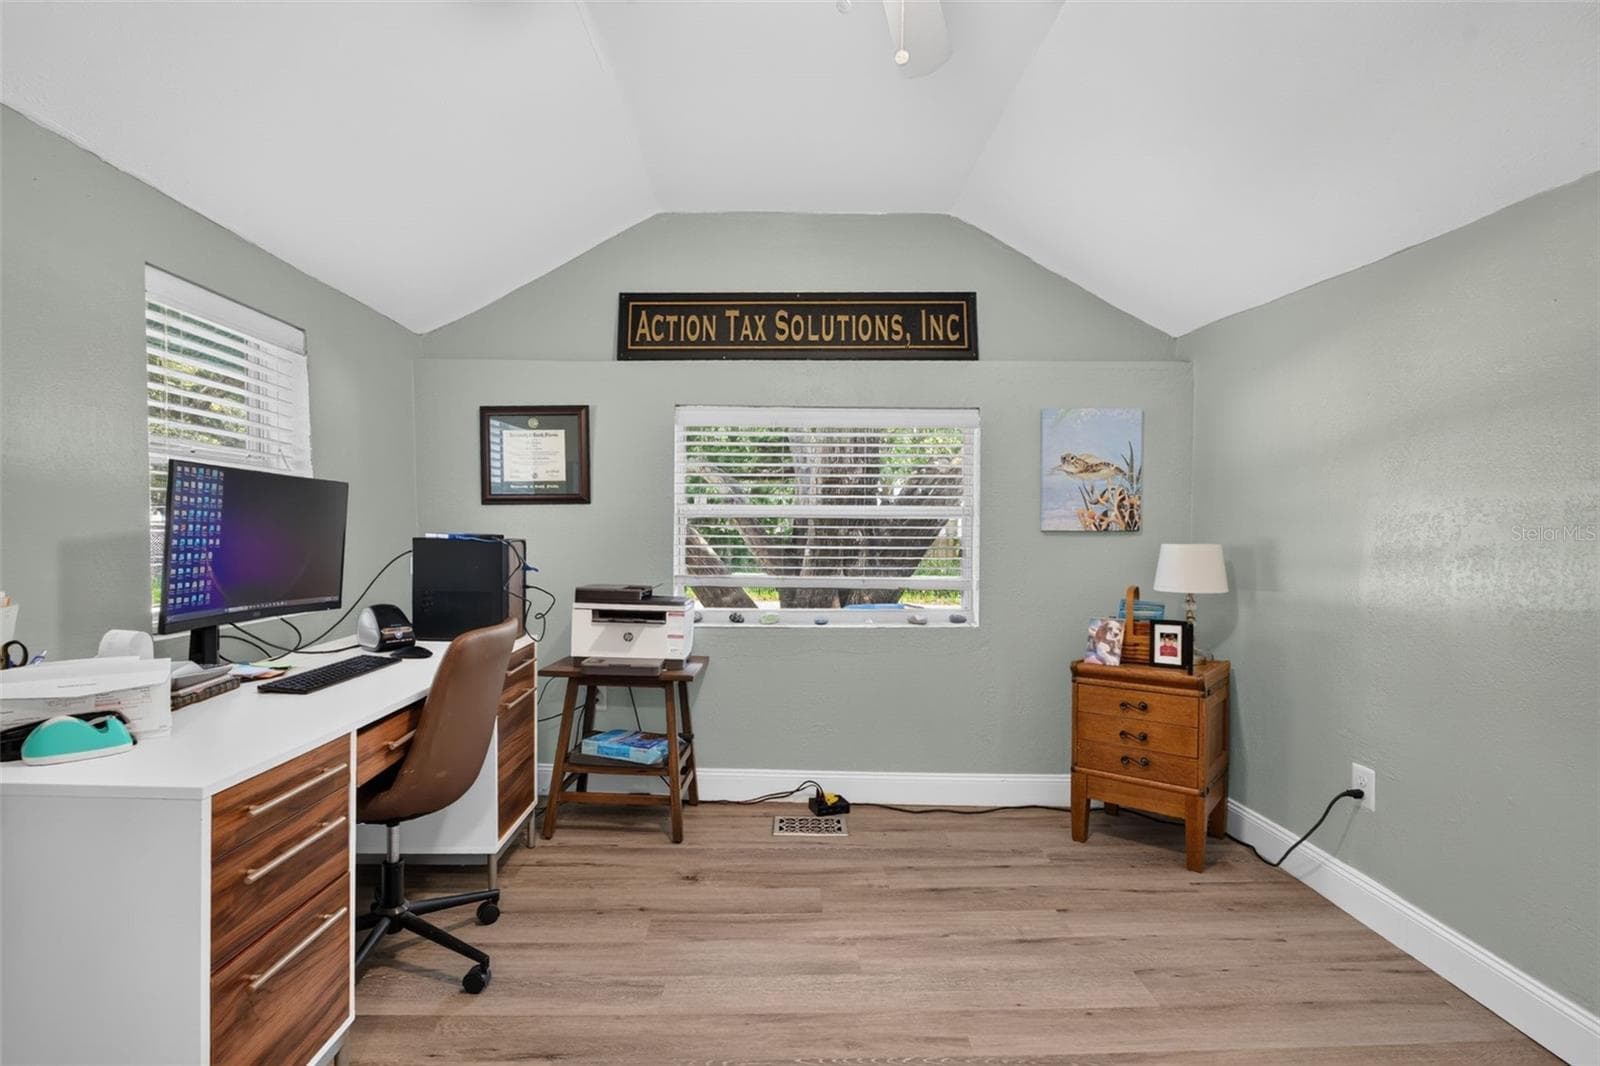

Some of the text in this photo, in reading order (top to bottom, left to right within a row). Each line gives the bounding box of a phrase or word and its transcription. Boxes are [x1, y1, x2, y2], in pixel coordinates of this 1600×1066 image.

[635, 309, 961, 346] ACTION TAX SOLUTIONS, INC
